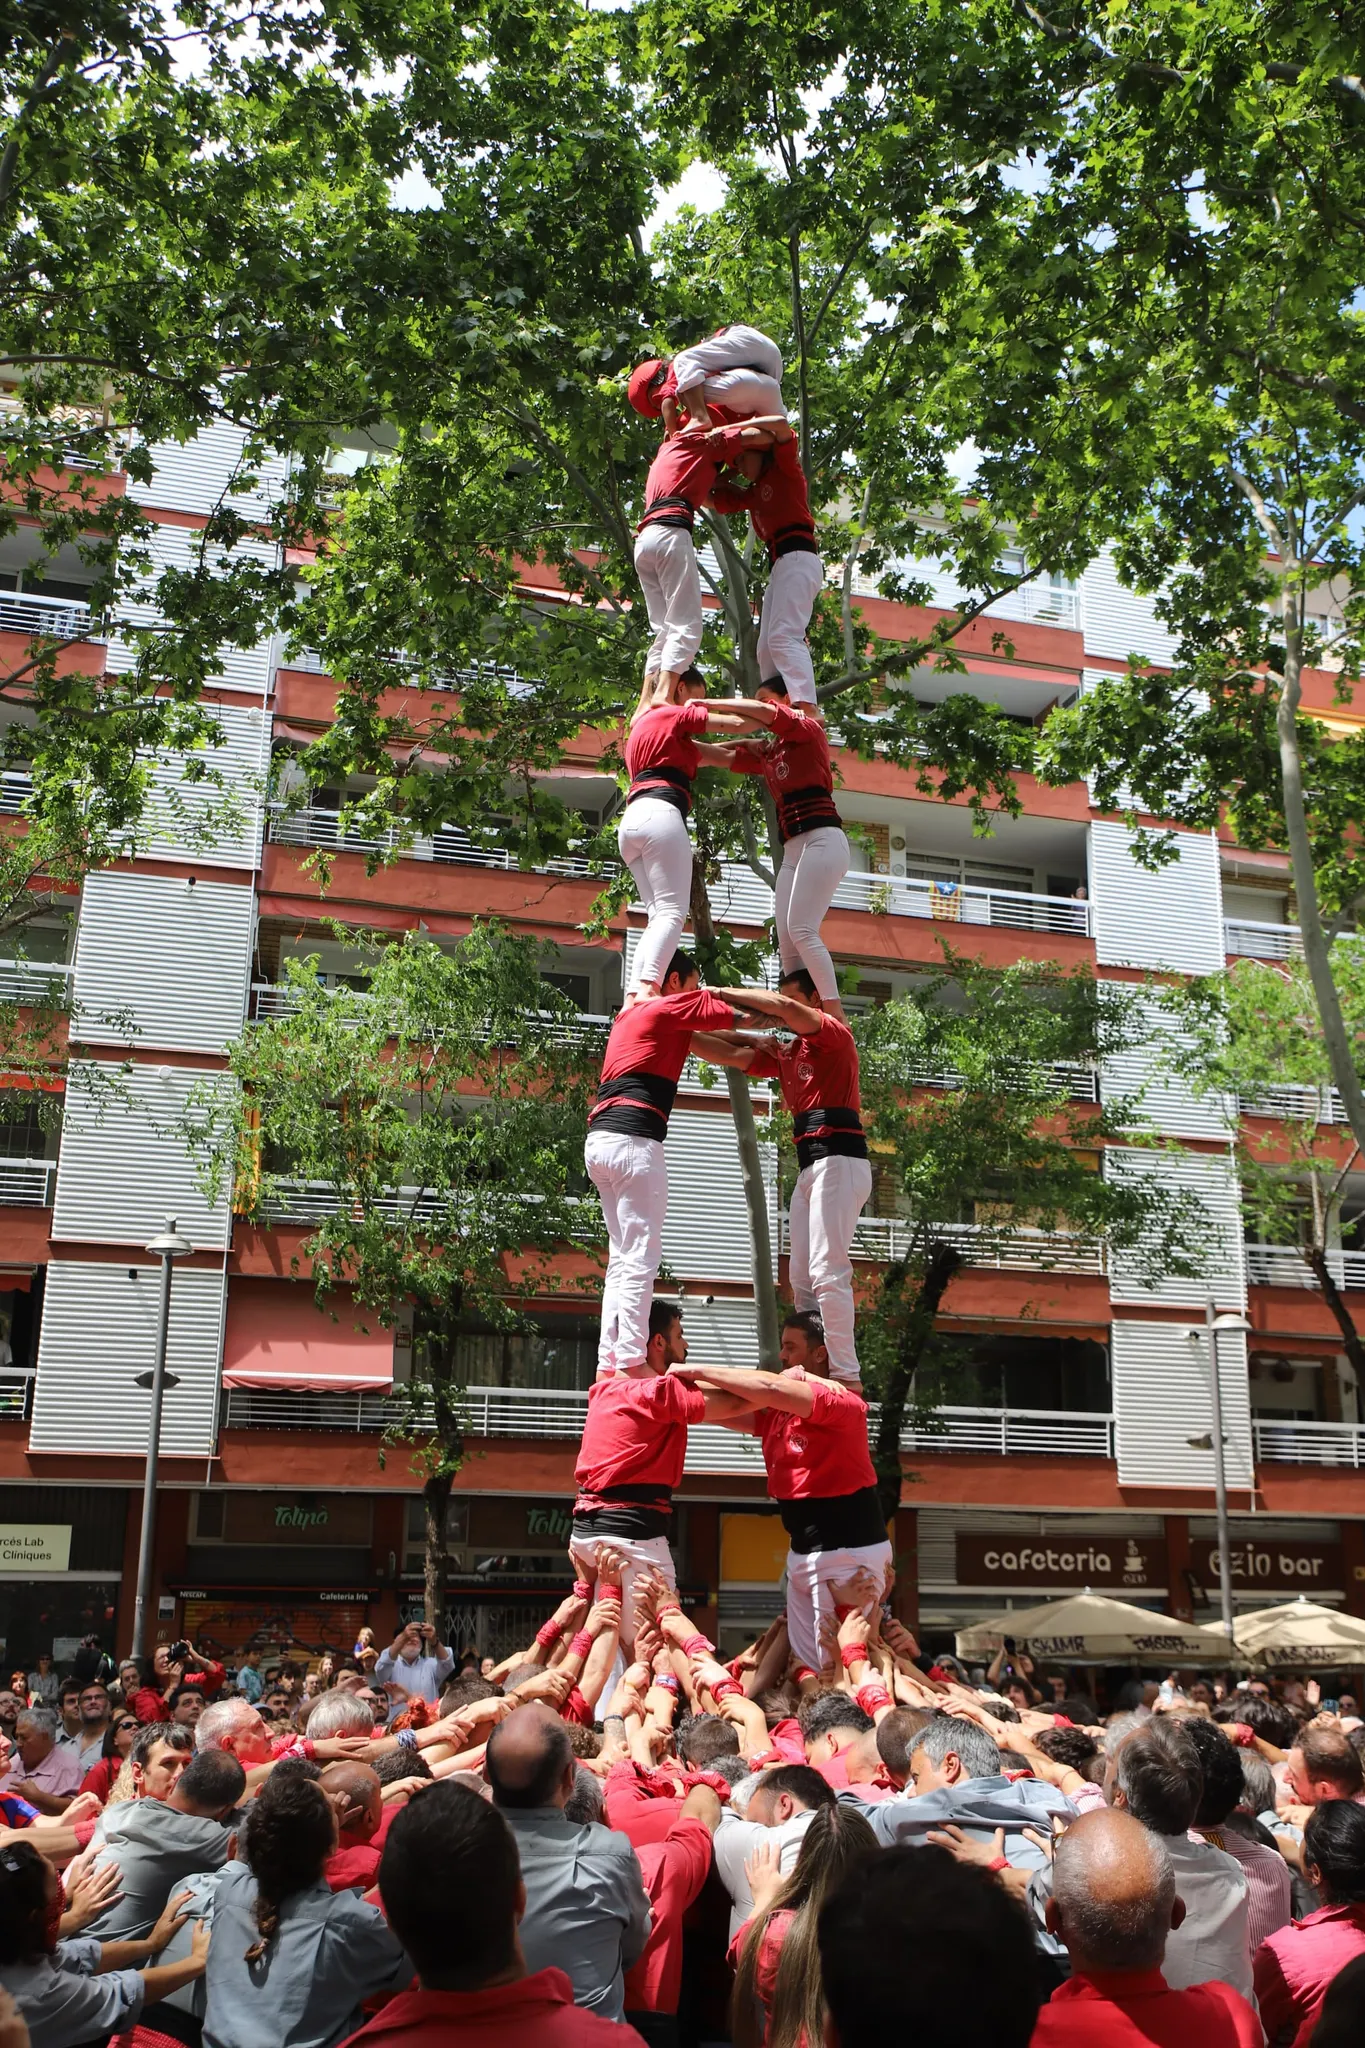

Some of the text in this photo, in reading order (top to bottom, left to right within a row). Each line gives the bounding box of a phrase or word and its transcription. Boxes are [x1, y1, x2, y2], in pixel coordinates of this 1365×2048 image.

[526, 1508, 573, 1543] Toli
[24, 1537, 44, 1547] Lab
[3, 1550, 52, 1562] Clíniques
[984, 1547, 1112, 1572] cafeteria
[1279, 1554, 1324, 1576] bar
[320, 1592, 369, 1601] Cafeteria Iris
